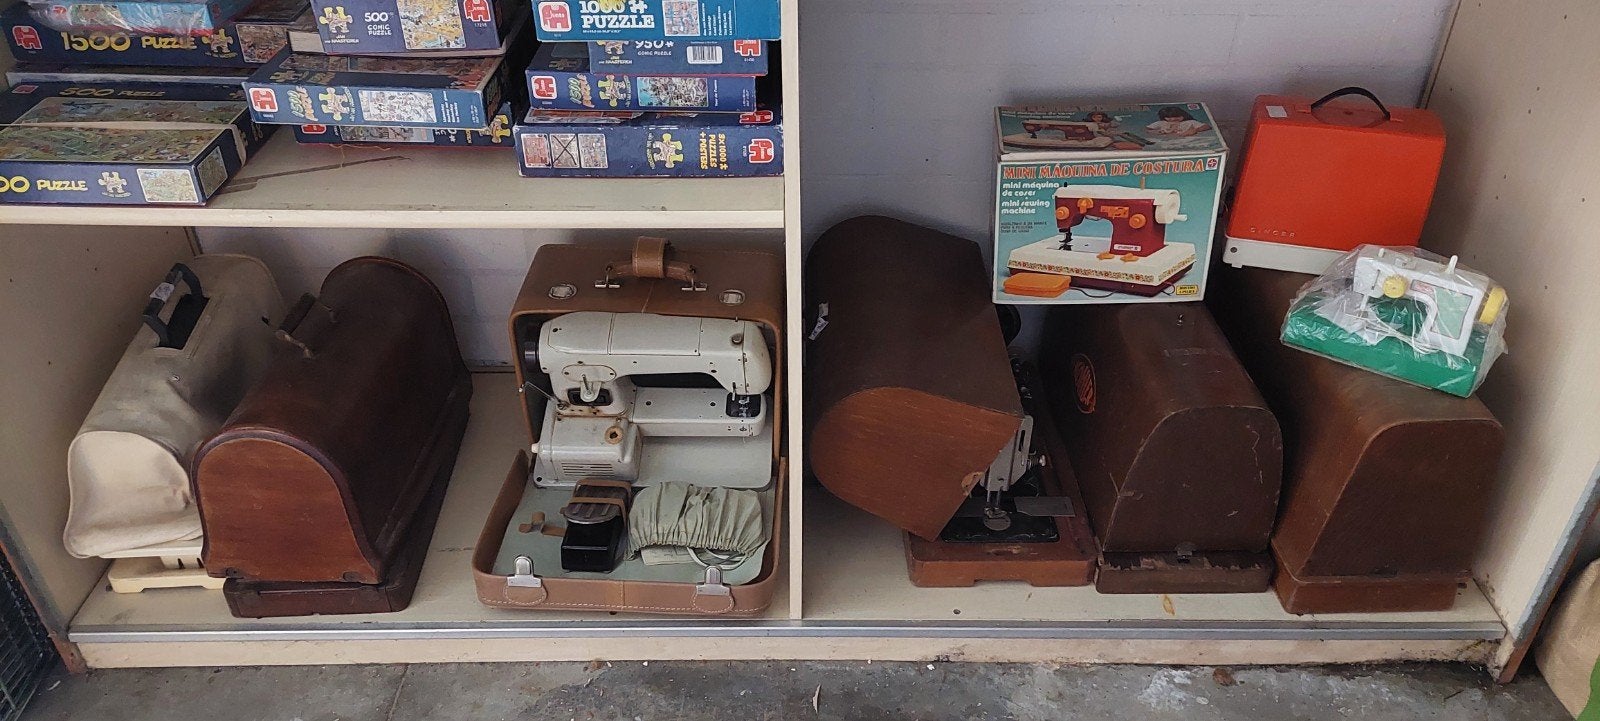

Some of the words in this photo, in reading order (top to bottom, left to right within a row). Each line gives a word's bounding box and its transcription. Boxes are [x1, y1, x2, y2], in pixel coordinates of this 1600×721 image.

[364, 12, 389, 22] 500
[580, 14, 655, 28] PUZZLE
[60, 31, 132, 52] 1500
[141, 36, 198, 50] PUZZLE
[634, 40, 665, 49] 950
[60, 88, 114, 97] 500
[568, 77, 582, 104] 1500
[286, 90, 304, 118] 1500
[296, 86, 318, 122] PUZZLE
[699, 138, 708, 170] POSTERS
[708, 134, 717, 168] PUZZLES
[1002, 166, 1036, 180] MINI
[1038, 163, 1107, 179] MÁQUINA
[1110, 162, 1130, 176] DE
[1132, 158, 1205, 175] COSTURA
[36, 179, 88, 192] PUZZLE
[1022, 181, 1060, 190] máquina
[1020, 200, 1050, 208] sewing
